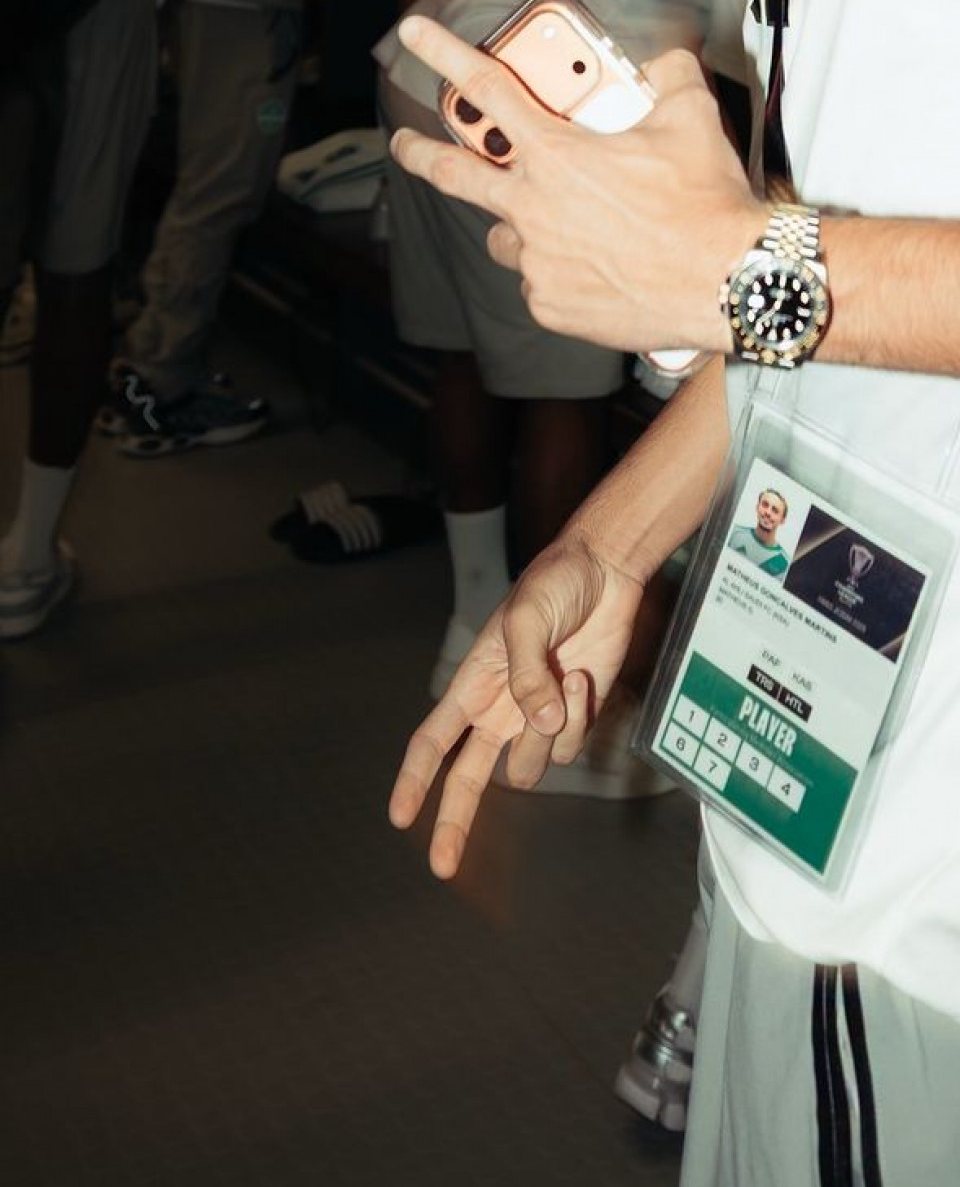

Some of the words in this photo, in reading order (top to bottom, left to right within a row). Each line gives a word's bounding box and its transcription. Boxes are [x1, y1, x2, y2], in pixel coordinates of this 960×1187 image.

[739, 695, 797, 758] PLAYER
[785, 693, 804, 714] HTL
[675, 735, 686, 752] 6
[707, 760, 717, 776] 7
[687, 708, 695, 723] 1
[716, 731, 728, 747] 2
[748, 754, 760, 772] 3
[780, 779, 792, 797] 4
